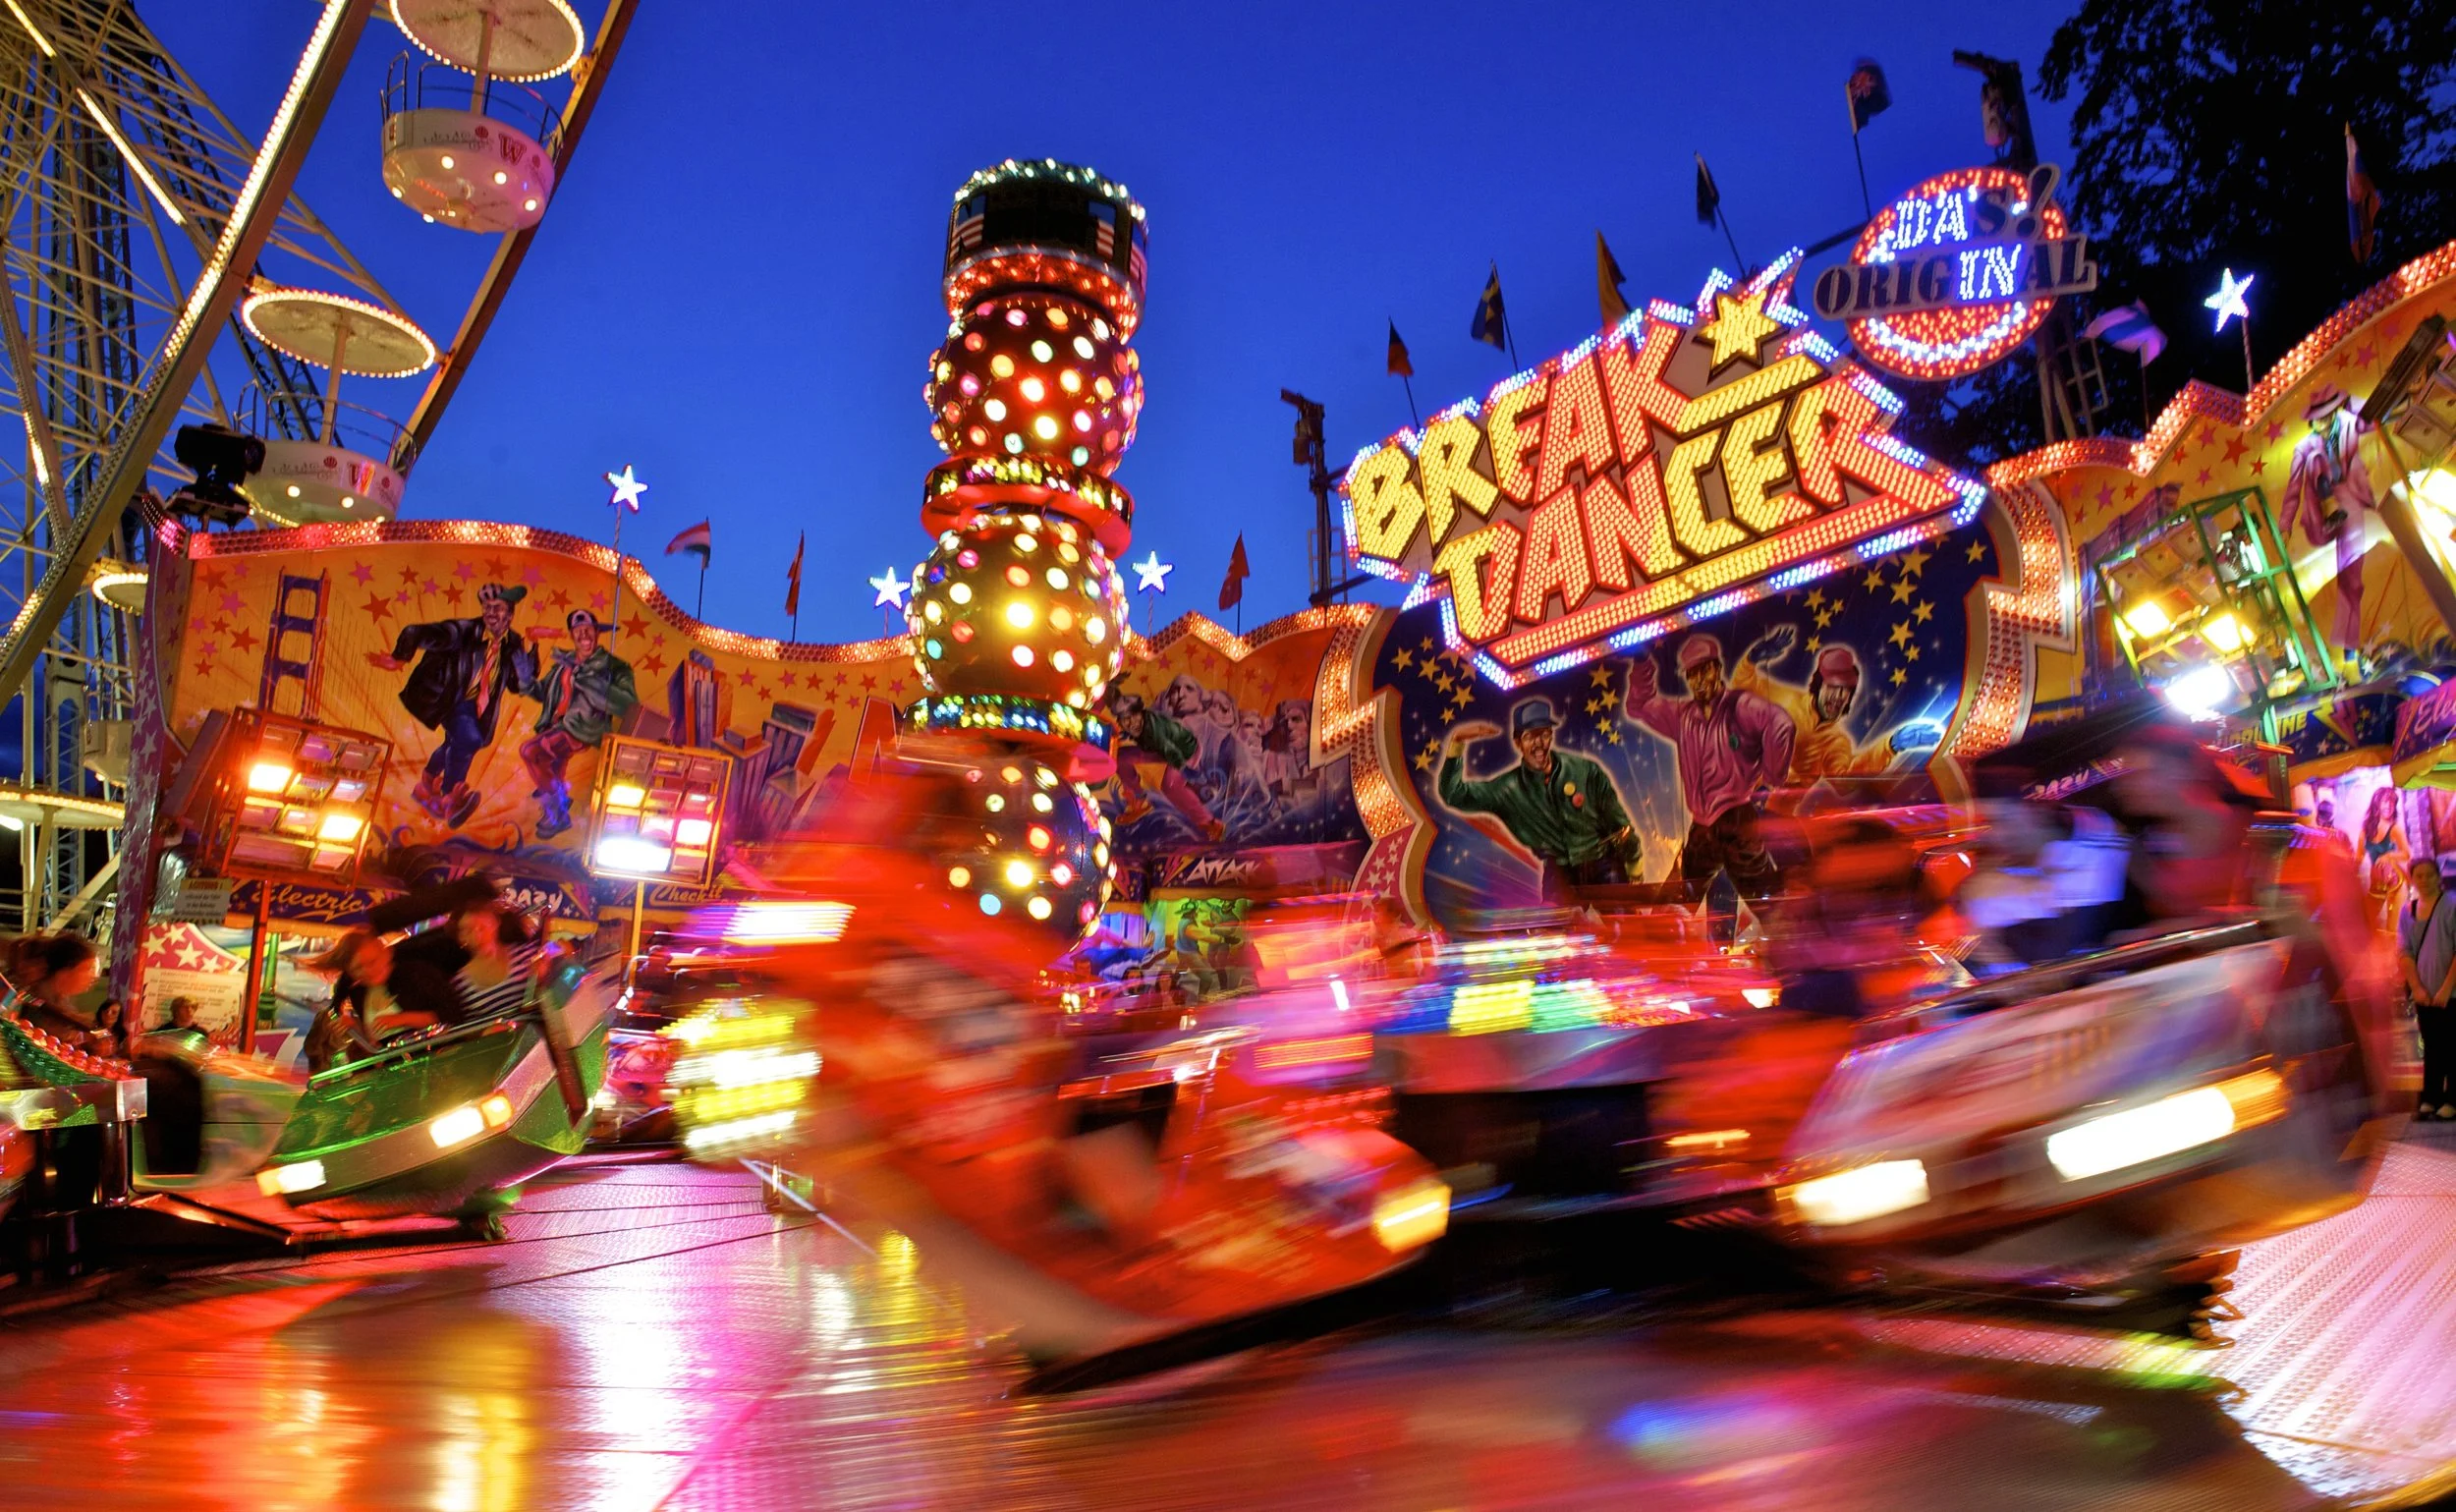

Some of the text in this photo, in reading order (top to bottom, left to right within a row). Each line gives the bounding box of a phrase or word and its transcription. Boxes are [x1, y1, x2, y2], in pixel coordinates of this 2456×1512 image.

[499, 133, 528, 166] W
[1814, 234, 2098, 320] ORIGINAL
[1349, 322, 1704, 563] BREAK
[1431, 373, 1960, 644] DANCER
